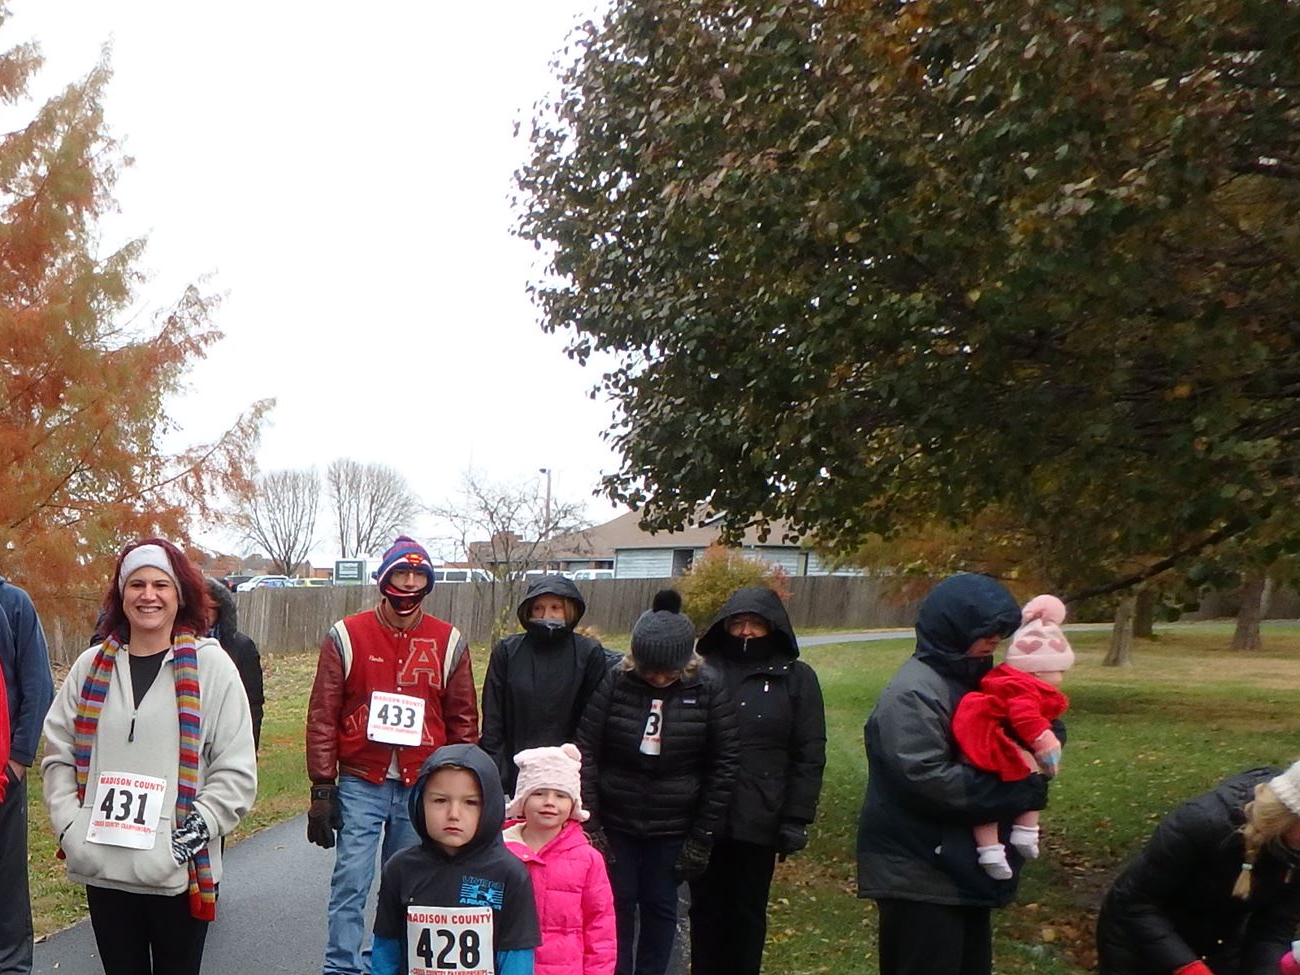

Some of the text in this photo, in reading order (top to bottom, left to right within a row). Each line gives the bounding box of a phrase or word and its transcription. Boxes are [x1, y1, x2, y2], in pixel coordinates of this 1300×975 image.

[397, 638, 442, 690] A
[377, 704, 416, 729] 433
[100, 777, 165, 792] MADISON COUNTY
[100, 788, 148, 825] 431
[406, 913, 491, 924] MADISON COUNTY
[416, 928, 480, 969] 428
